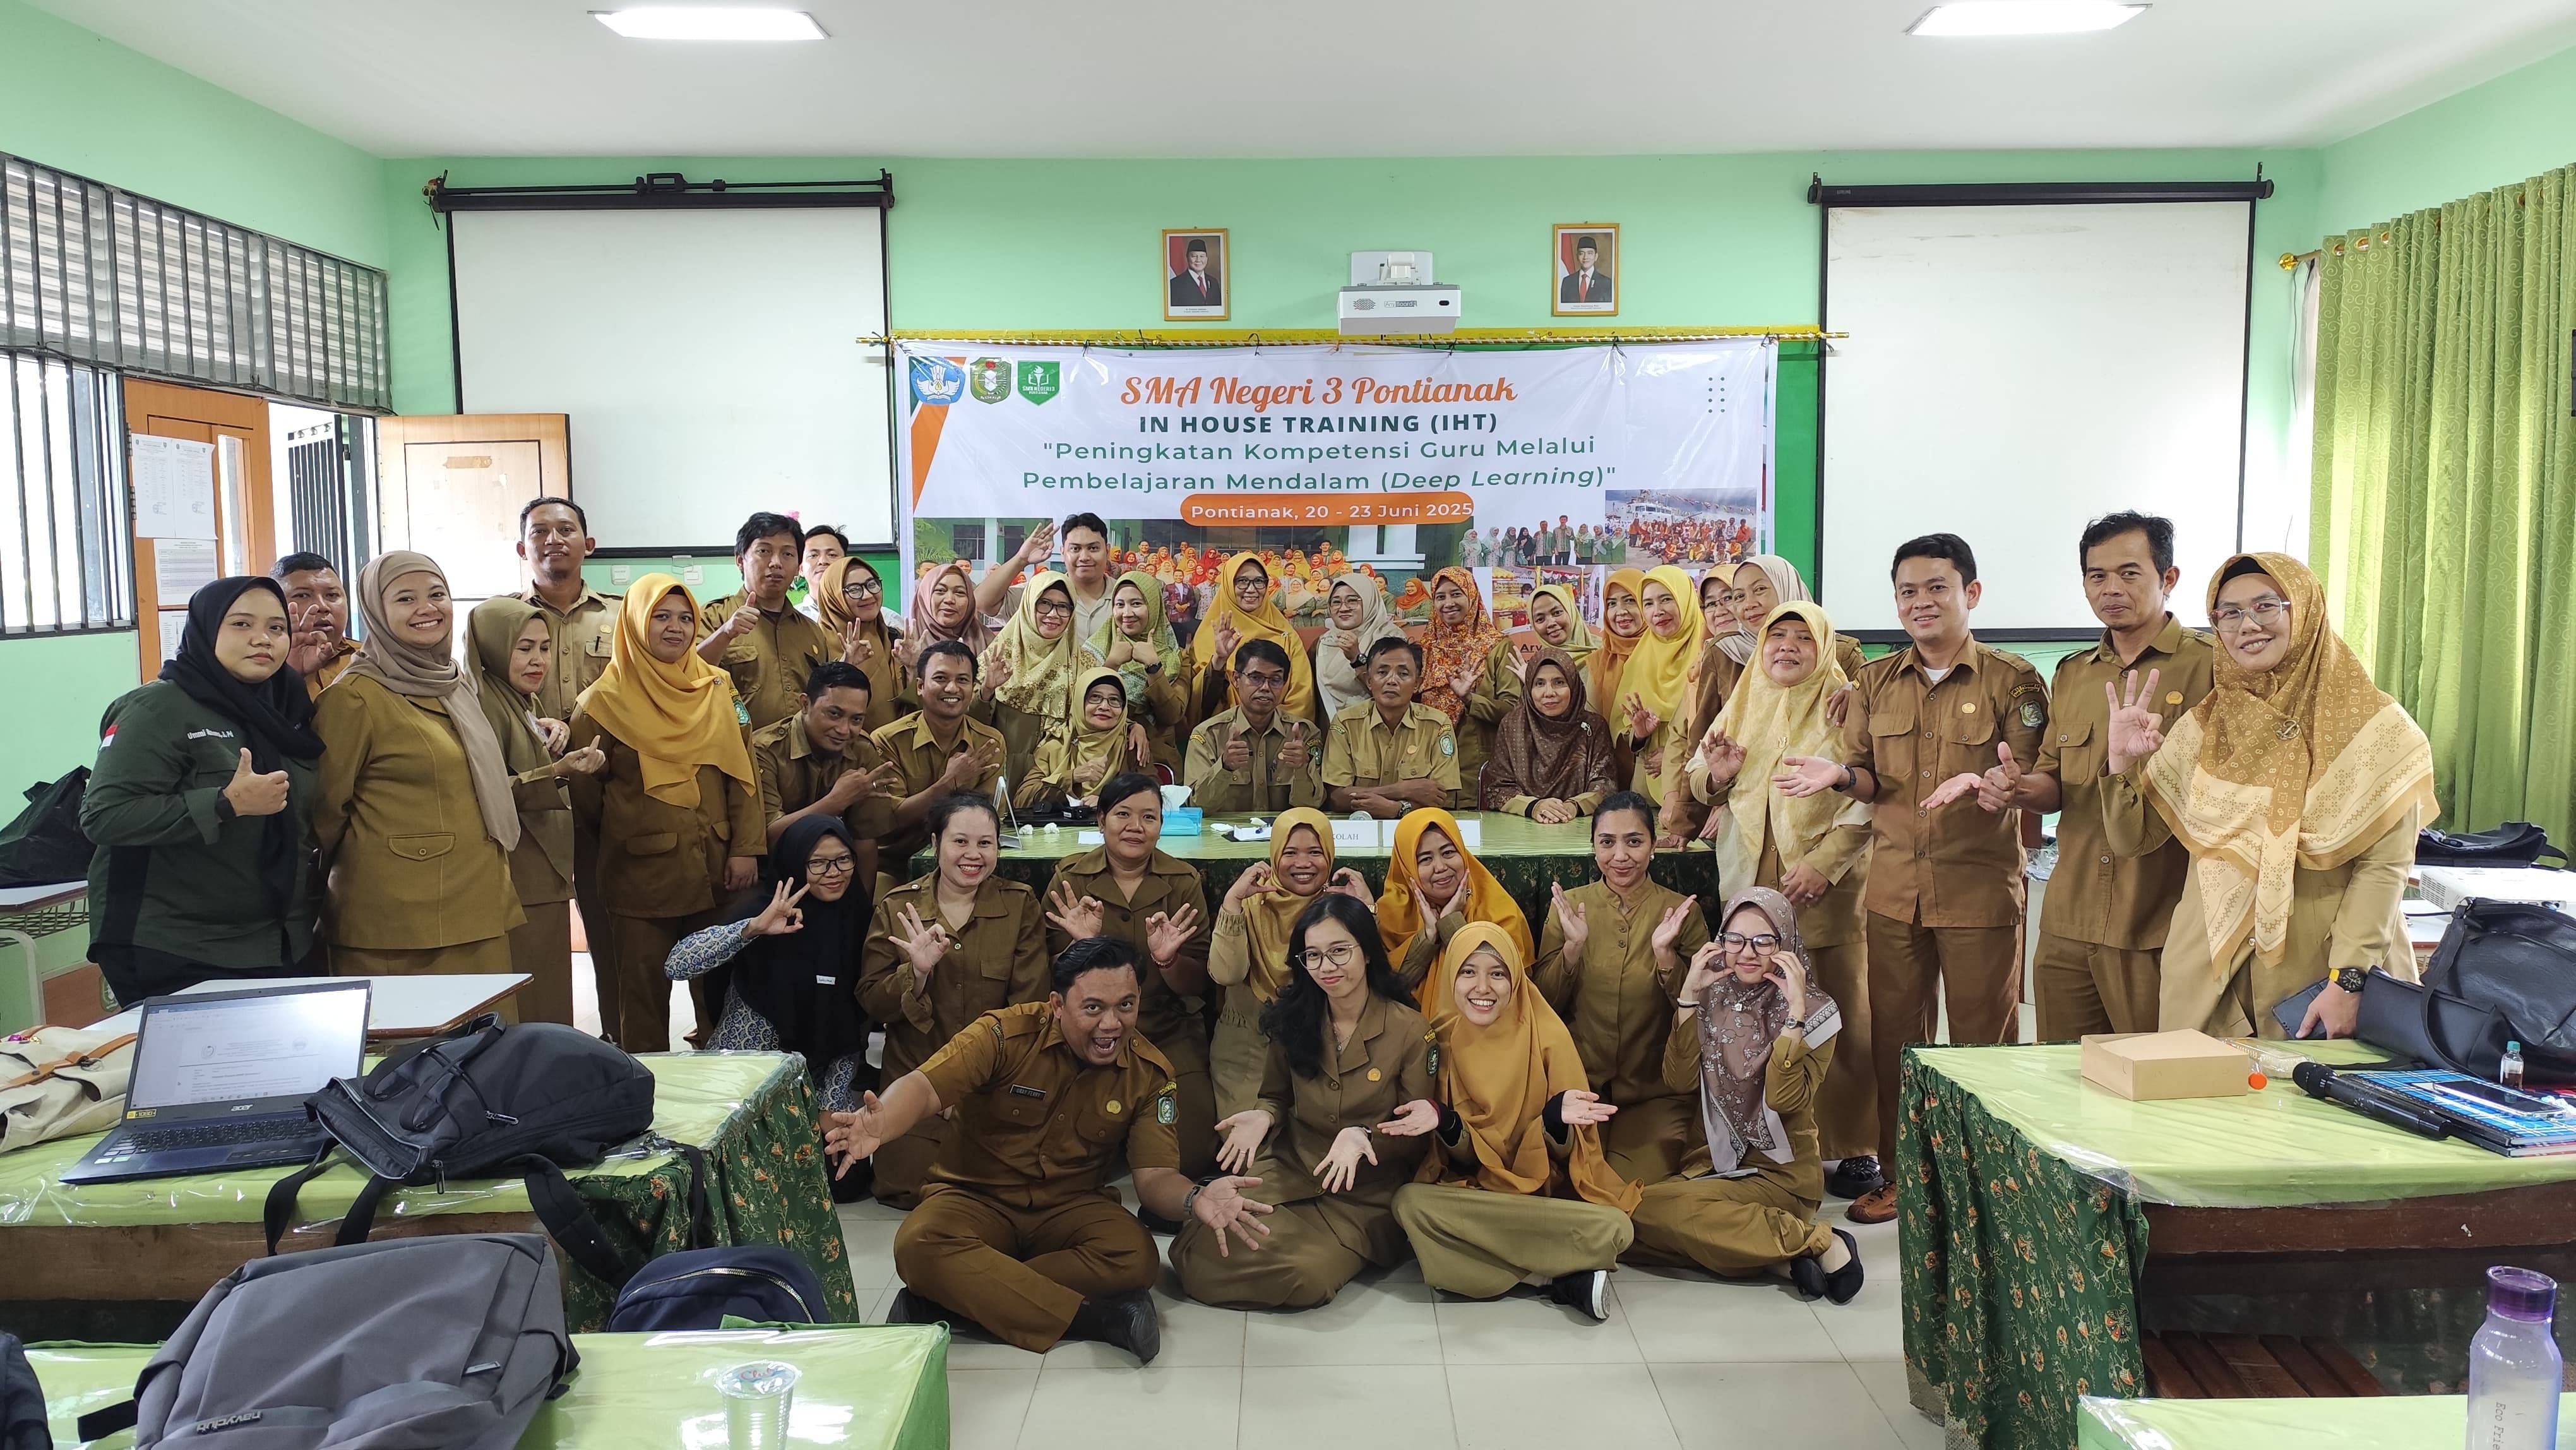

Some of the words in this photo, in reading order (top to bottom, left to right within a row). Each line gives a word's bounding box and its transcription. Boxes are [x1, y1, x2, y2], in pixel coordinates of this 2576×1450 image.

[1121, 376, 1202, 407] SMA
[1210, 377, 1315, 413] Negeri
[1323, 378, 1342, 404] 3
[1352, 377, 1518, 404] Pontianak
[1140, 416, 1168, 433] IN
[1181, 416, 1272, 433] HOUSE
[1282, 415, 1419, 433] TRAINING
[1431, 413, 1497, 434] (IHT)
[1044, 441, 1232, 464] "Peningkatan
[1245, 441, 1409, 464] Kompetensi
[1420, 441, 1484, 458] Guru
[1497, 436, 1595, 457] Melalui
[1023, 472, 1214, 493] Pembelajaran
[1227, 472, 1369, 489] Mendalam
[1381, 472, 1460, 493] (Deep
[1471, 466, 1615, 488] Learning)"
[1191, 505, 1299, 520] Pontianak,
[1305, 506, 1328, 518] 20
[1349, 505, 1371, 518] 23
[1378, 503, 1419, 518] Juni
[1426, 503, 1472, 517] 2025
[2495, 1401, 2506, 1422] Eco
